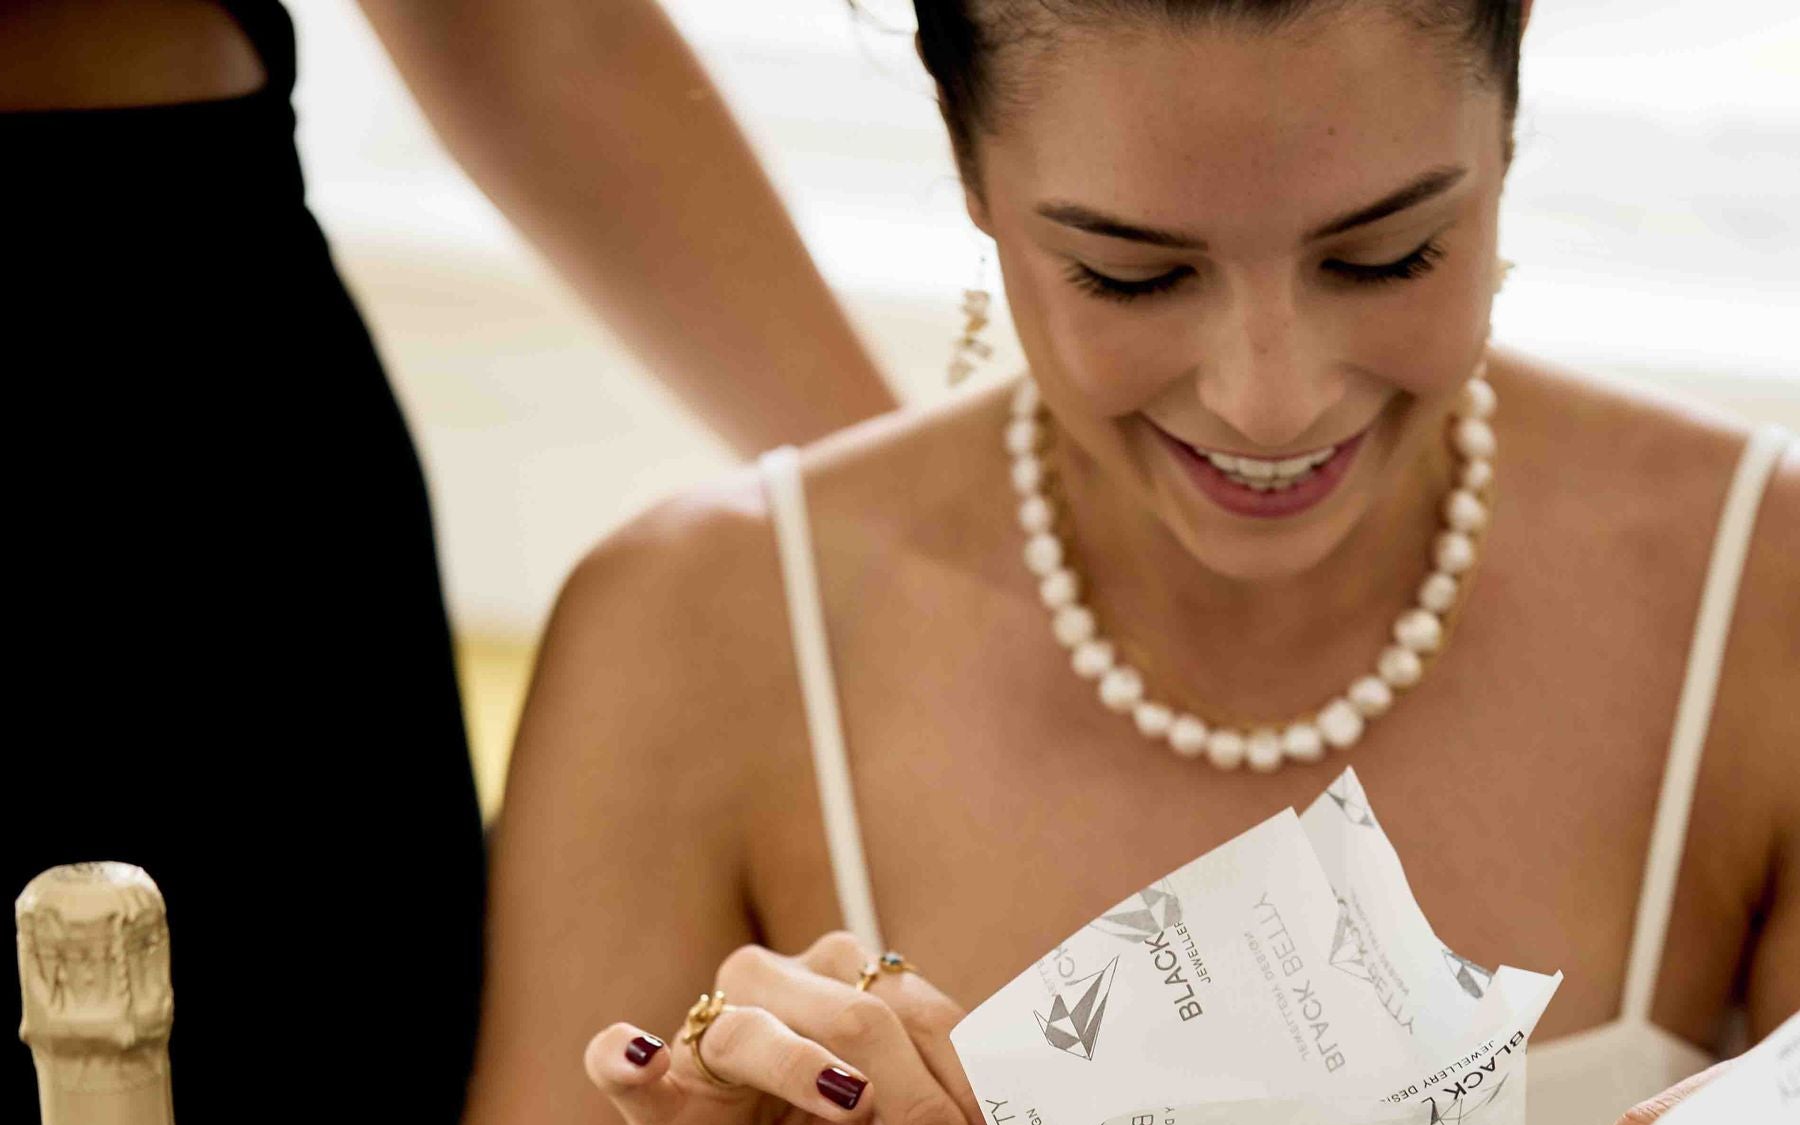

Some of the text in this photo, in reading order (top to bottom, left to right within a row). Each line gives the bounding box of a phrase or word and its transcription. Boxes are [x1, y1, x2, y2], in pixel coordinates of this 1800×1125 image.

[1144, 931, 1203, 1022] BLACK
[1422, 1039, 1495, 1089] JEWELLERY
[1442, 1030, 1525, 1101] BLACK
